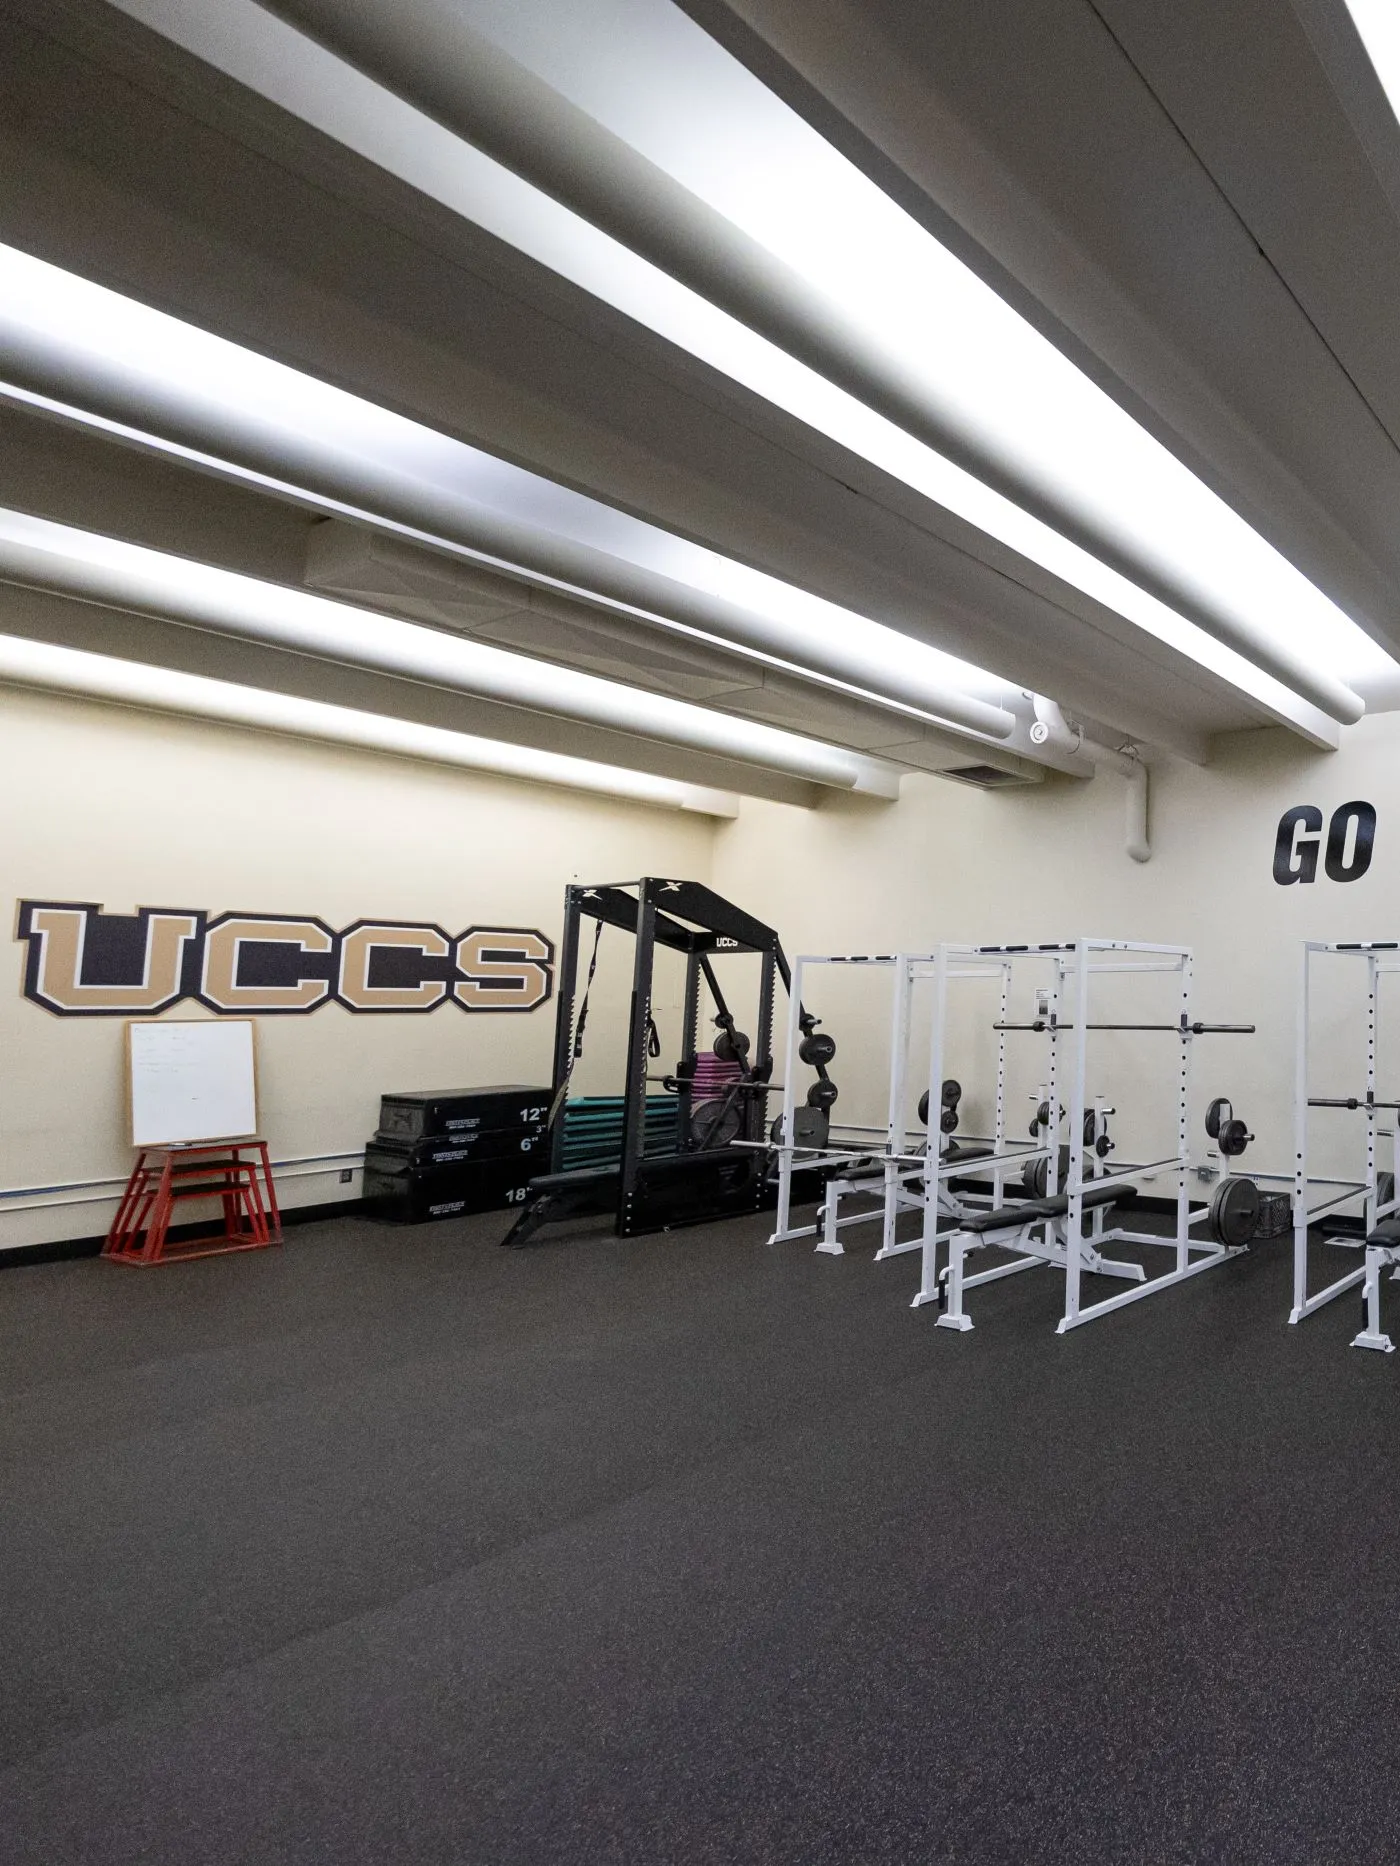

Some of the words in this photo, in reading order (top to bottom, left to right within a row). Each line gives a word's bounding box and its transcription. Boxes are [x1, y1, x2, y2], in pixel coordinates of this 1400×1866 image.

[1273, 801, 1377, 886] GO
[17, 899, 555, 1016] UCCS
[520, 1107, 548, 1122] 12"
